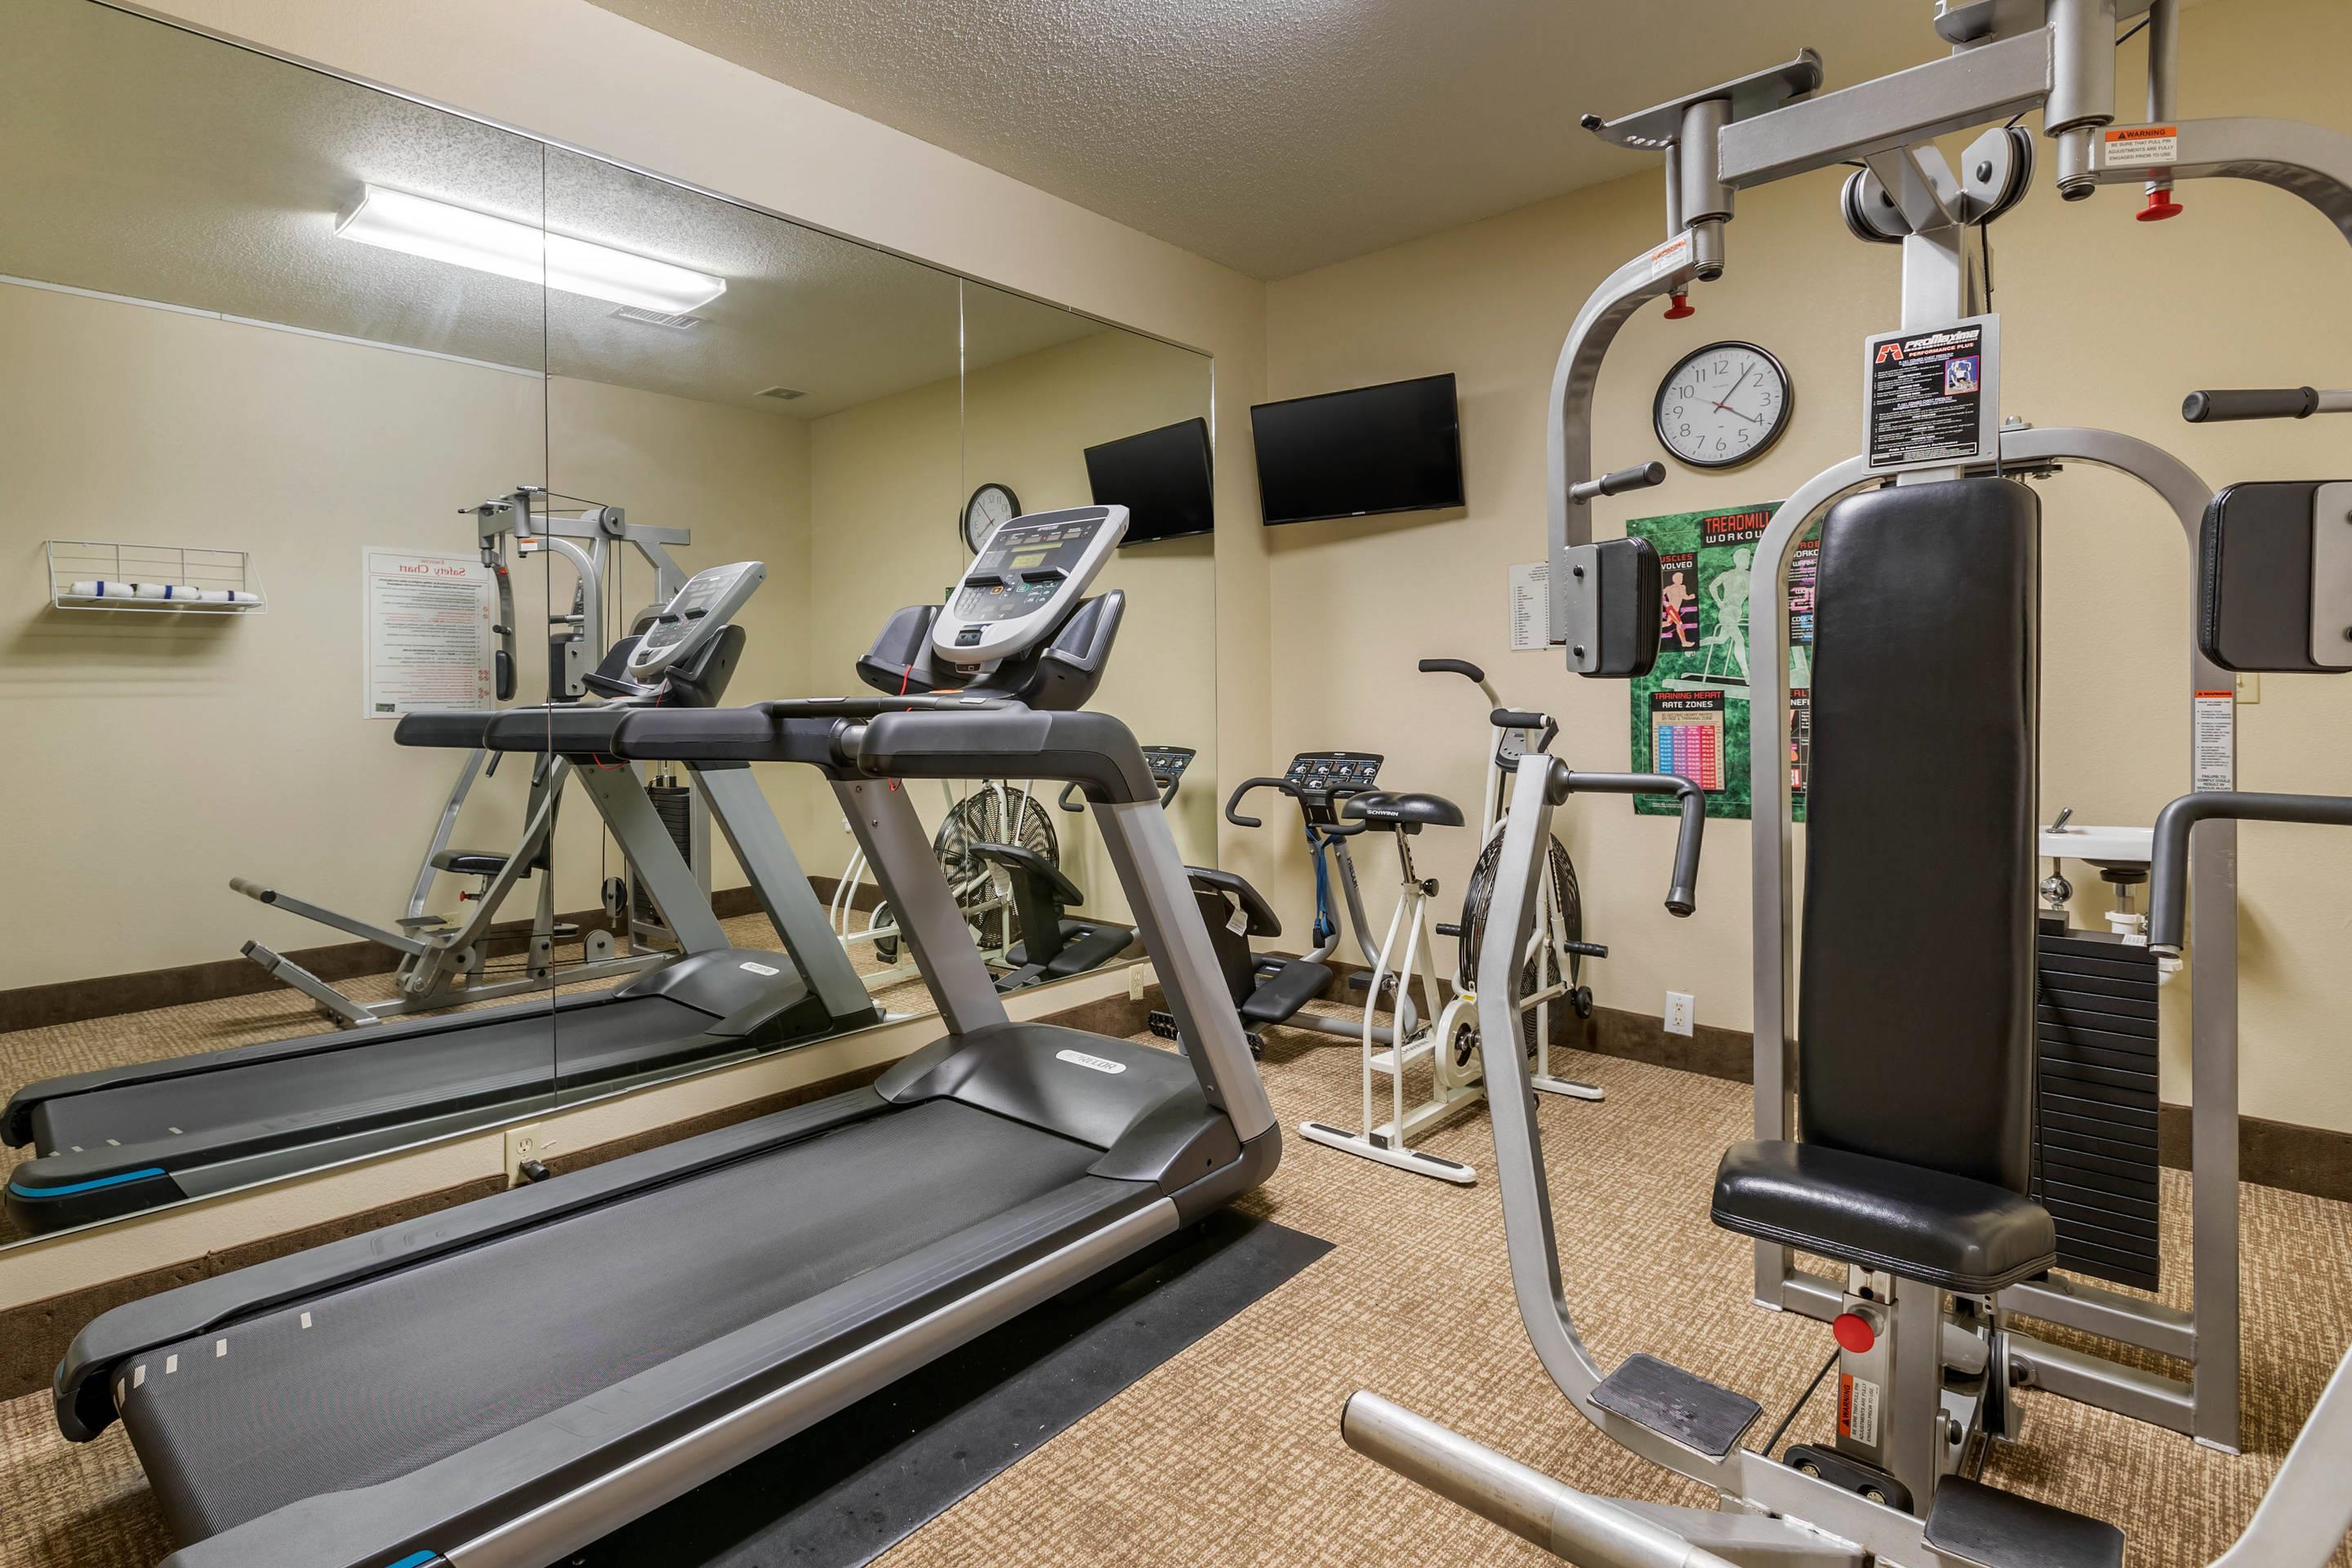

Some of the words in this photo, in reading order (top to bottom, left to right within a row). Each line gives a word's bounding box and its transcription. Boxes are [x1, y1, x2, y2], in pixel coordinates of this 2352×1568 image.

[2127, 130, 2165, 138] WARNING
[1909, 345, 1956, 357] PERFORMANCE
[1713, 360, 1729, 375] 12
[1695, 368, 1705, 382] 11
[1753, 373, 1763, 387] 2
[1679, 385, 1695, 399] 10
[1760, 392, 1771, 406] 3
[1673, 406, 1684, 419] 9
[1754, 412, 1764, 425] 4
[1680, 423, 1690, 437] 8
[1738, 429, 1748, 443] 5
[1695, 435, 1705, 449] 7
[1715, 437, 1726, 451] 6
[1706, 530, 1762, 543] WORKOU
[1075, 1054, 1117, 1070] PRECOR
